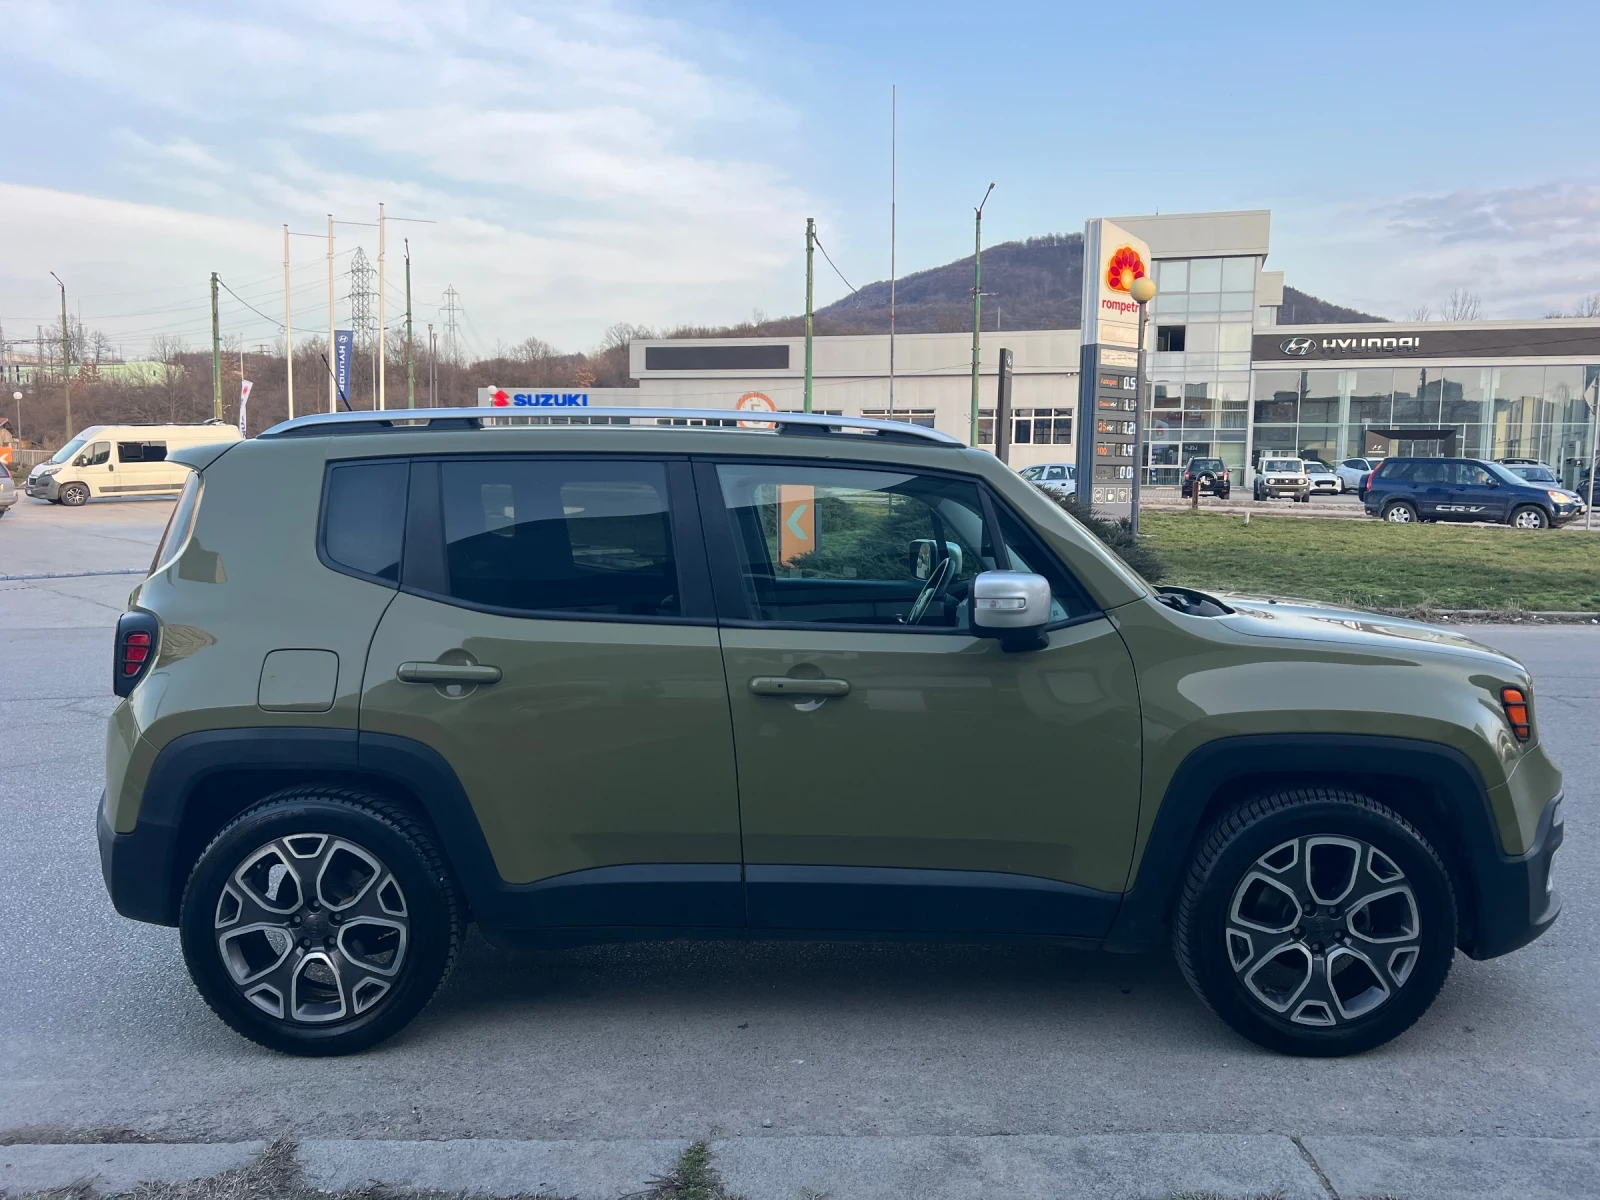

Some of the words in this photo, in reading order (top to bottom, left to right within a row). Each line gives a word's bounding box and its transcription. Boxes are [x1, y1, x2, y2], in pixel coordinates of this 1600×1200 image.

[1102, 299, 1147, 315] rompetrl
[1322, 337, 1420, 353] HYUNDAI
[1123, 376, 1138, 390] 0.5
[513, 393, 588, 407] SUZUKI
[1123, 421, 1136, 436] 1.2
[1122, 441, 1134, 457] 1.4
[1435, 504, 1486, 512] CR-V
